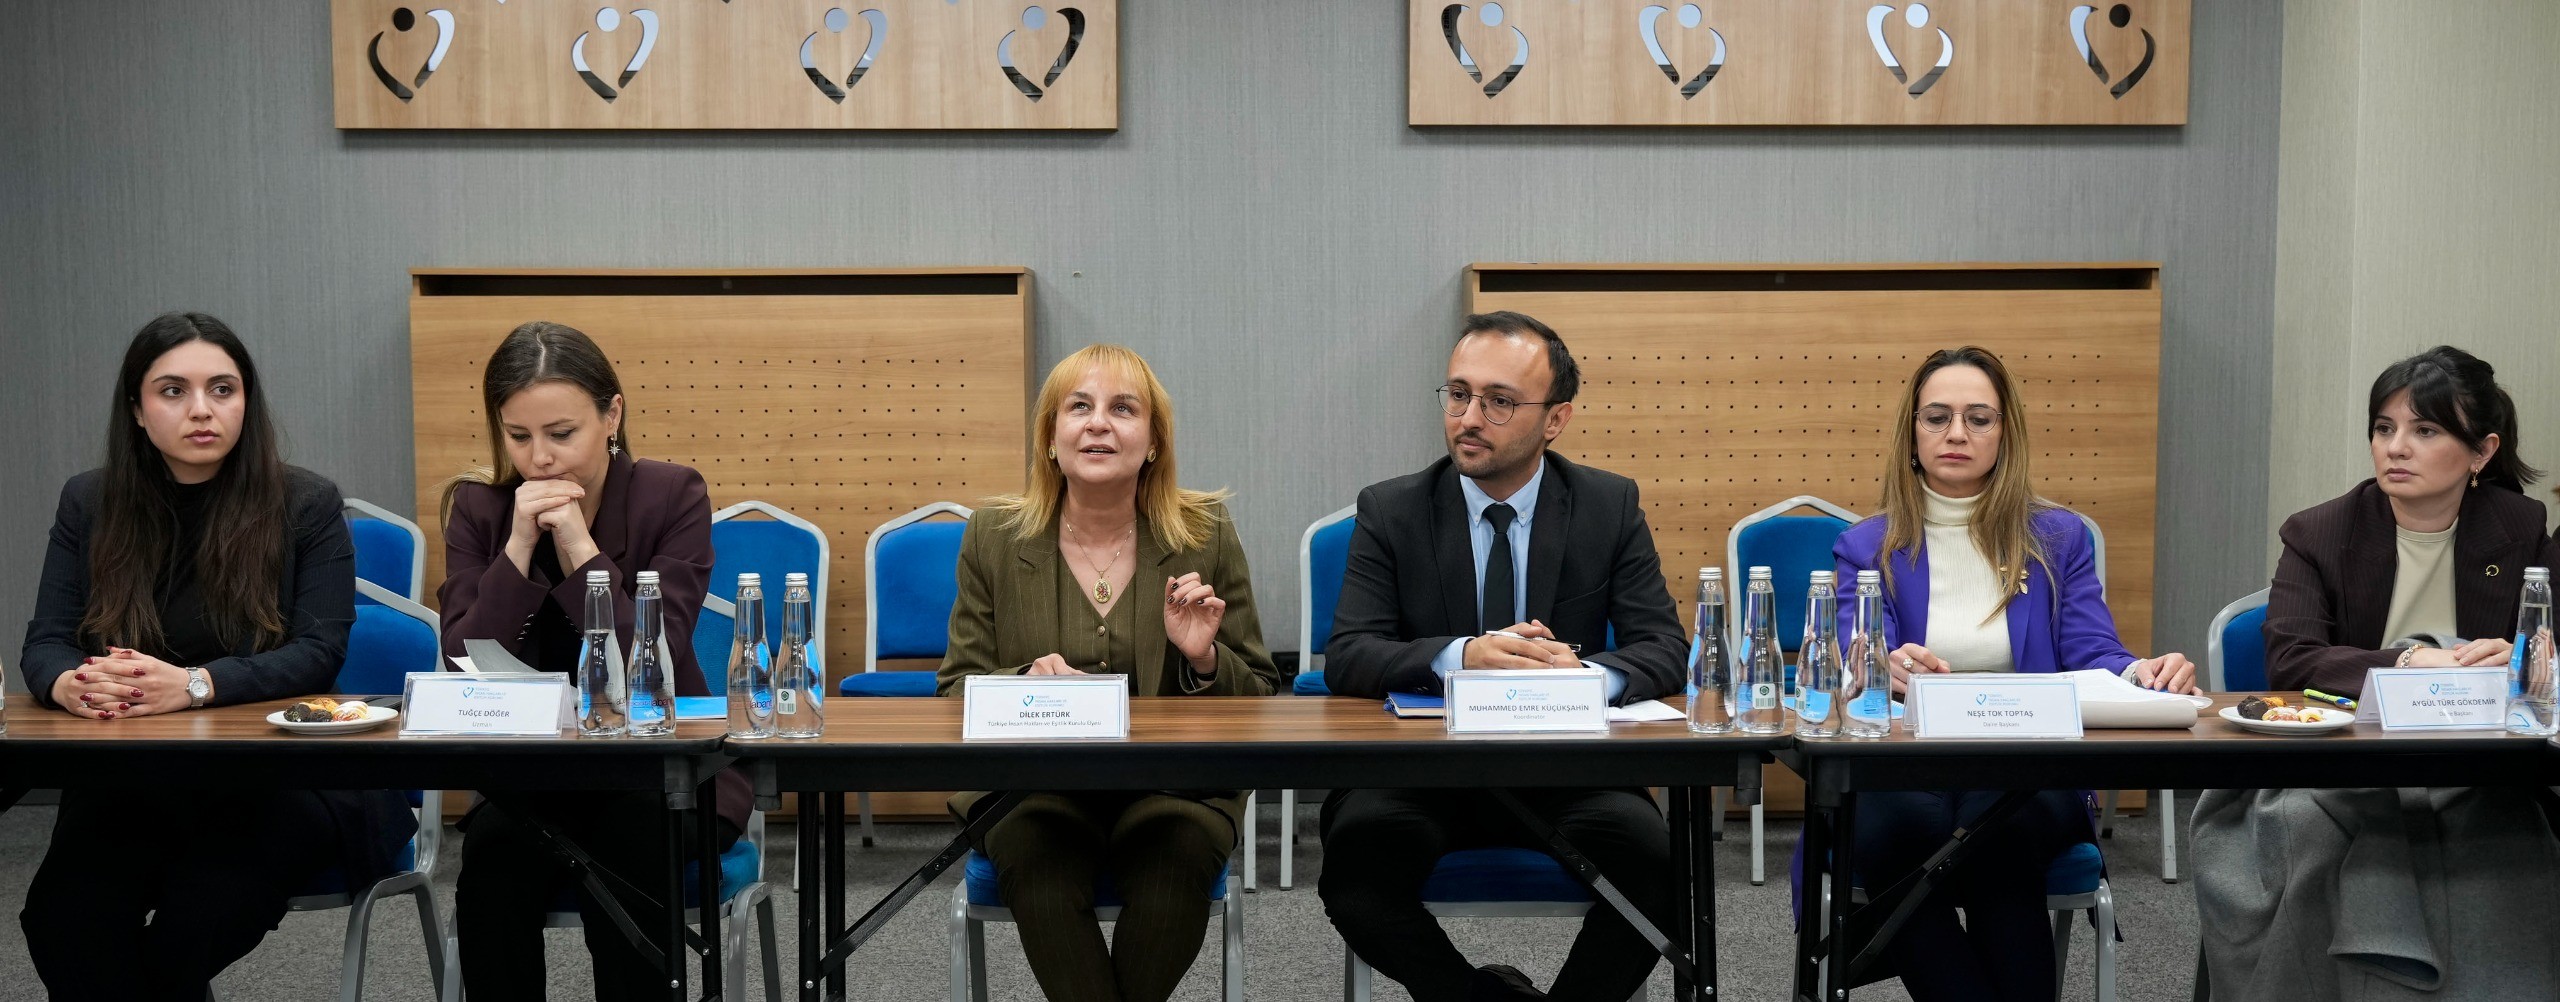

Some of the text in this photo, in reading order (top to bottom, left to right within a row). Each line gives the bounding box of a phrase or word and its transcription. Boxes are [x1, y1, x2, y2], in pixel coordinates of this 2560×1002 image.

[2412, 698, 2497, 707] AYGÜL TÜRE GÖKDEMİR
[1541, 704, 1590, 712] KÜÇÜKŞAHİN
[458, 709, 510, 717] TUĞÇE DÖĞER
[1019, 711, 1040, 719] DİLEK
[1967, 710, 1986, 718] NEŞE
[2004, 710, 2034, 718] TOPTAŞ
